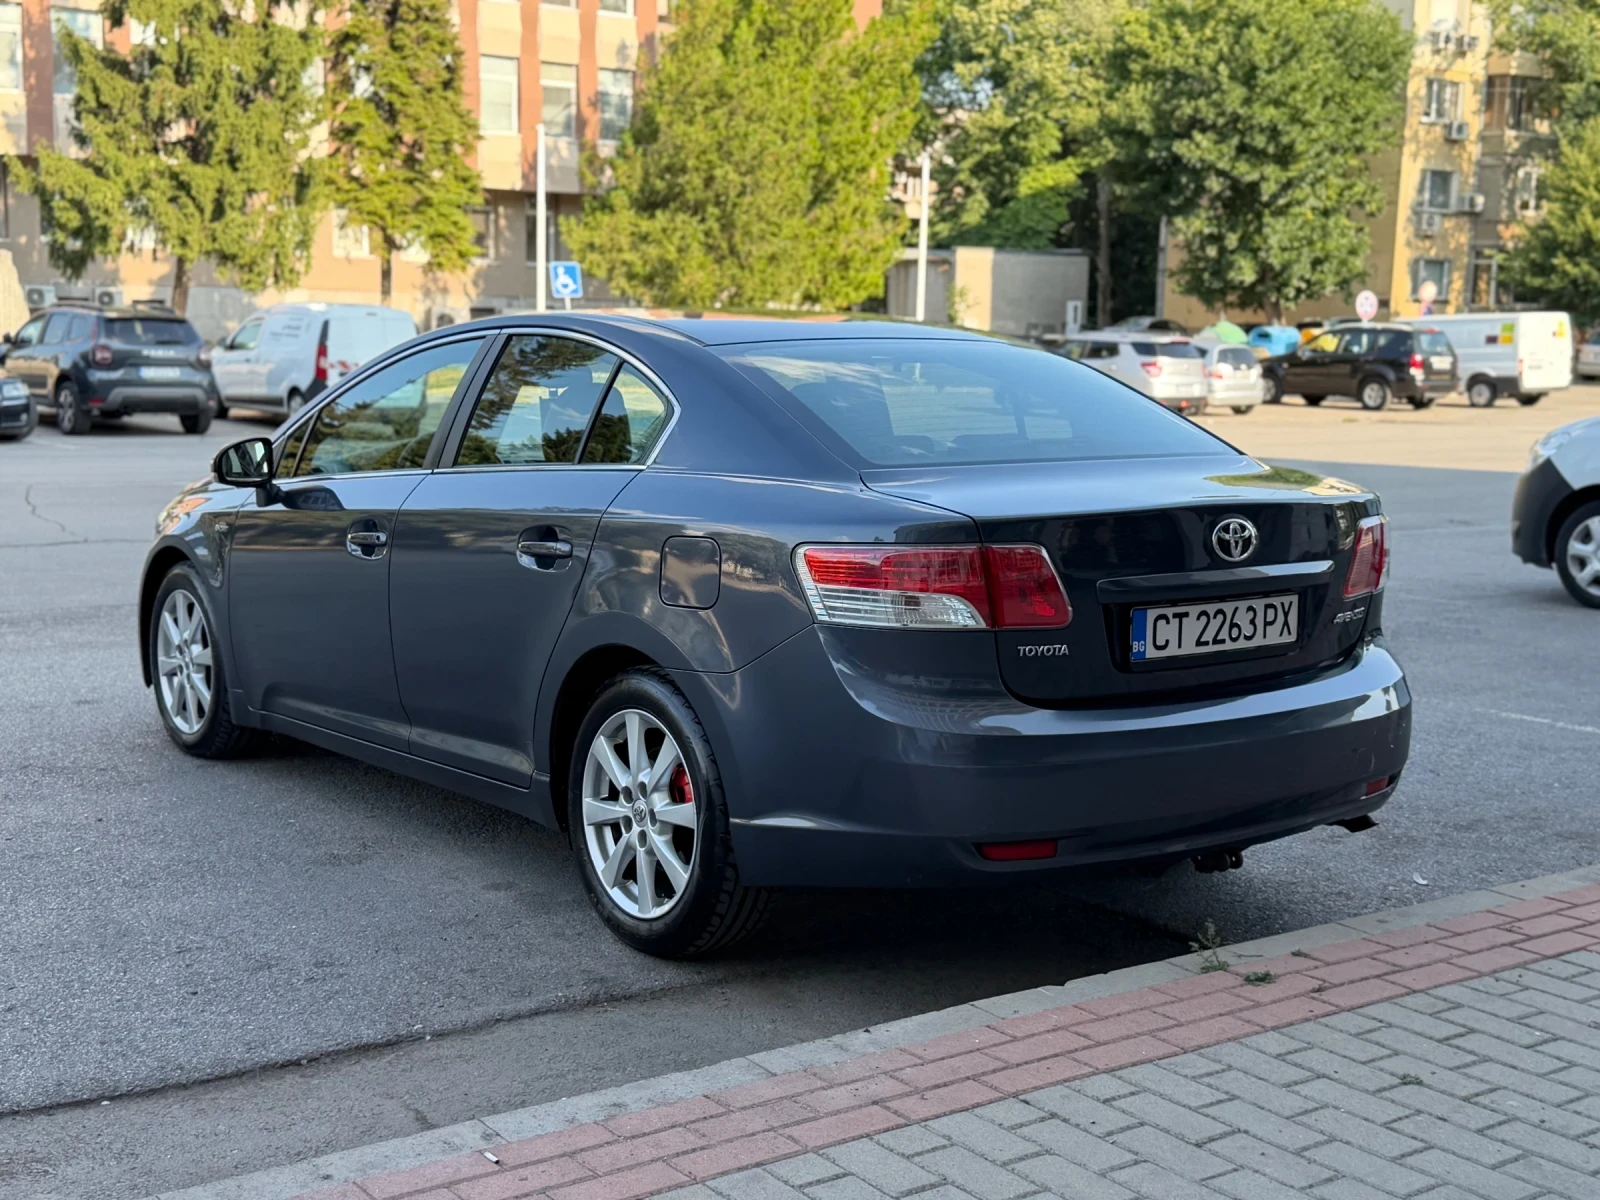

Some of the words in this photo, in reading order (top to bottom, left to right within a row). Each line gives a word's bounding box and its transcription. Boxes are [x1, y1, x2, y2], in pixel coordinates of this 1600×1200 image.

[1152, 611, 1190, 651] CT
[1195, 604, 1257, 647] 2263
[1263, 600, 1293, 639] PX
[1017, 644, 1069, 657] TOYOTA
[1132, 640, 1145, 652] BG
